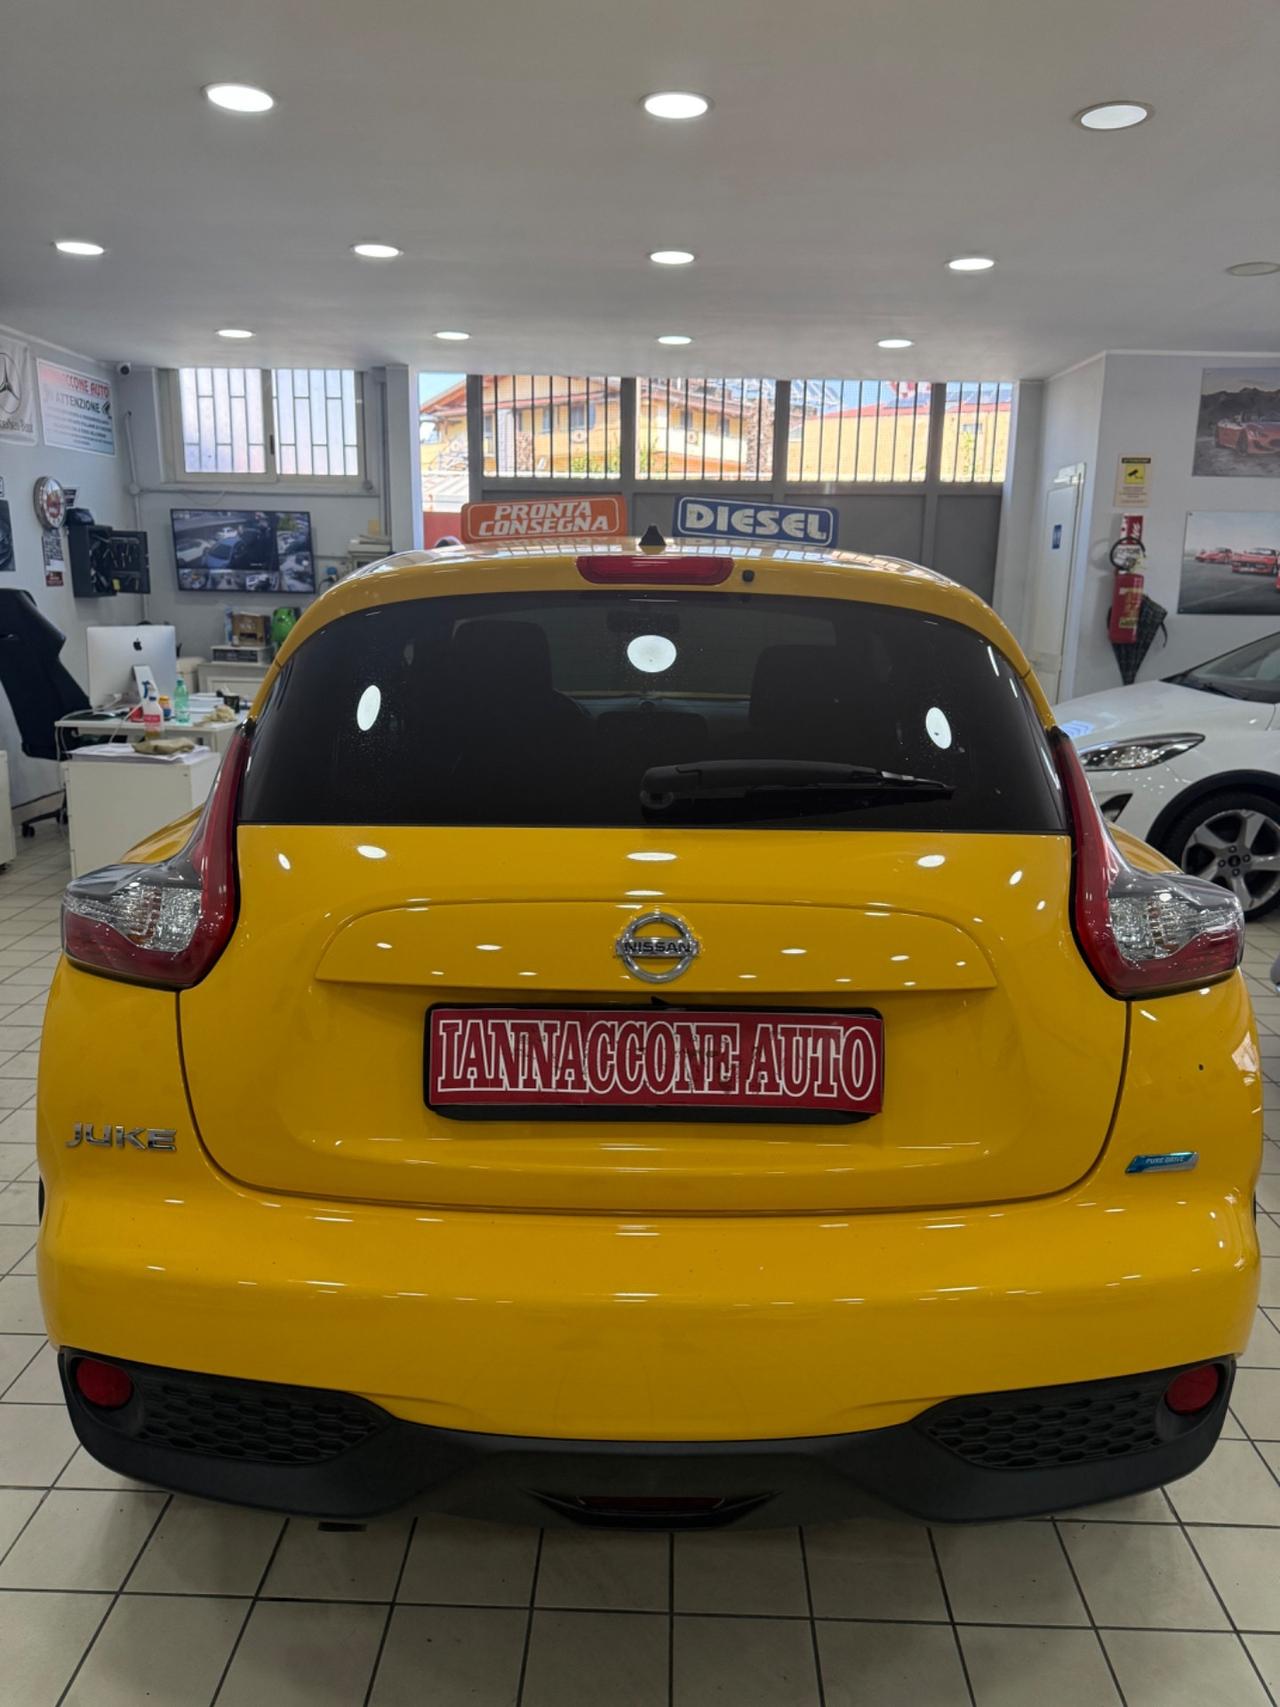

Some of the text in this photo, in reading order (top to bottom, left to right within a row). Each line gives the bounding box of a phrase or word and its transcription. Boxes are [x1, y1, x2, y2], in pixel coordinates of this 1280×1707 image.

[495, 502, 592, 520] PRONTA
[686, 504, 827, 539] DIESEL
[479, 516, 608, 536] CONSEGNA
[624, 941, 691, 952] NISSAN
[437, 1019, 876, 1101] IANNACCONE AUTO
[66, 1121, 177, 1150] JUKE
